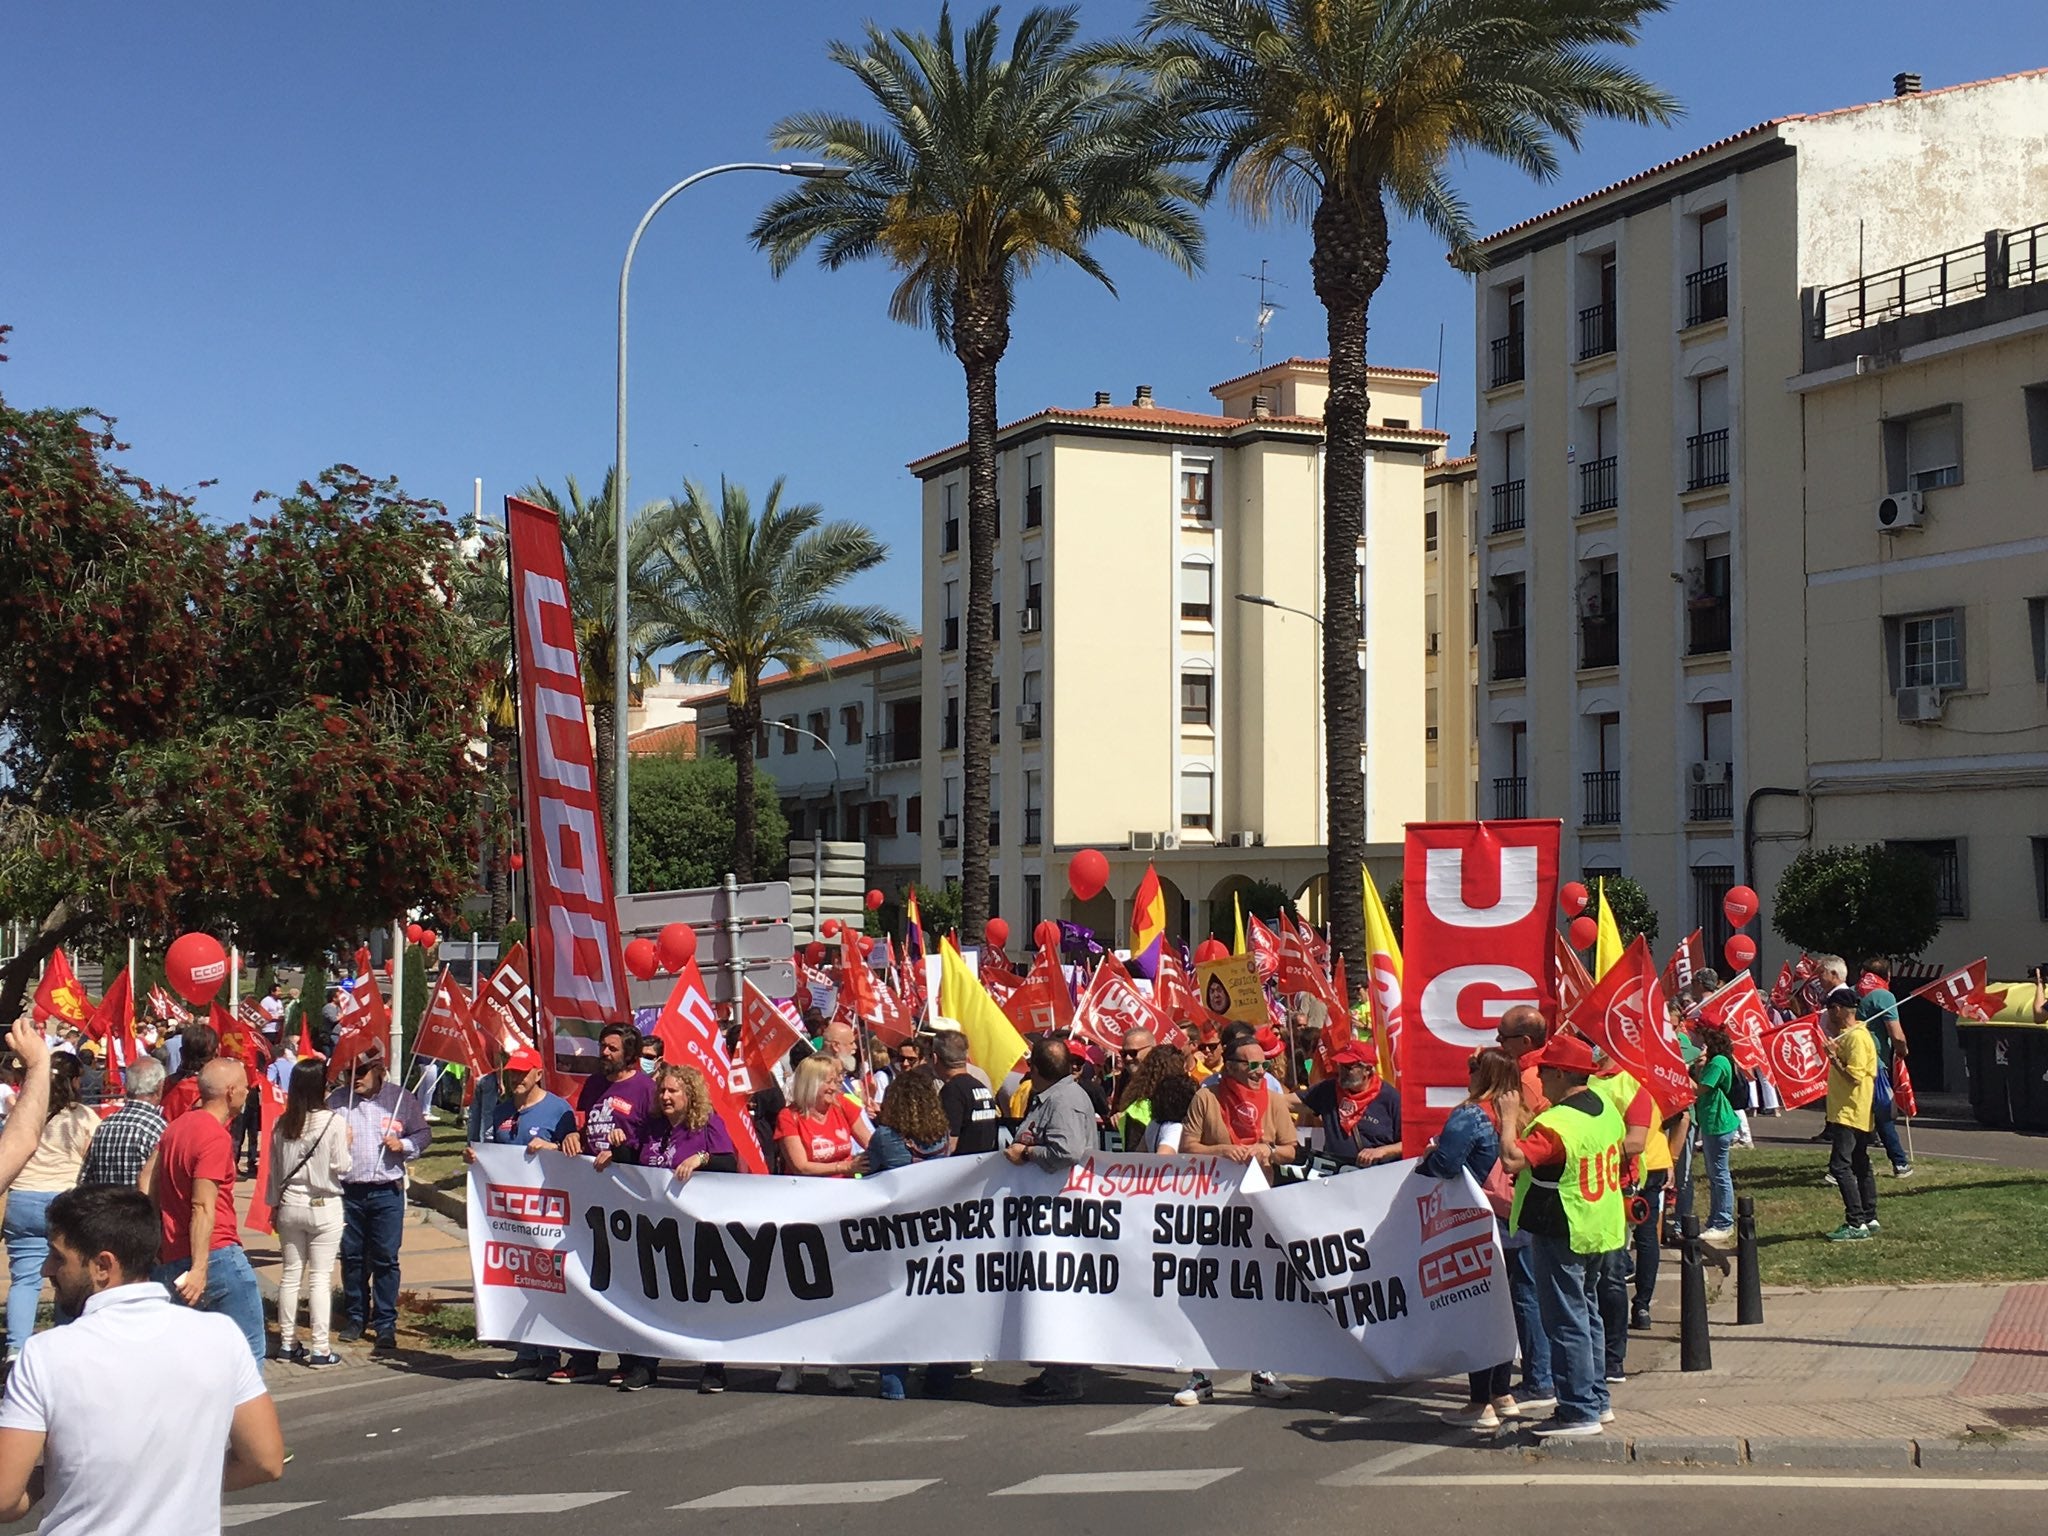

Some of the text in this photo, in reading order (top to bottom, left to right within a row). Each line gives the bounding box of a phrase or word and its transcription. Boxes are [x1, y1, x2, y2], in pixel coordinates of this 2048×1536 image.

[524, 569, 617, 1012] CCOO
[194, 963, 224, 978] CCOO
[1420, 845, 1540, 1108] UG
[1579, 1142, 1620, 1203] UG
[490, 1192, 565, 1218] CCOO
[839, 1195, 1122, 1252] CONTENER PRECIOS
[1152, 1203, 1254, 1248] SUBIR
[492, 1220, 562, 1238] extremadura
[487, 1245, 532, 1272] UGT
[905, 1246, 1120, 1296] MÁS IGUALDAD
[1152, 1252, 1220, 1298] POR
[1230, 1259, 1264, 1300] LA
[1429, 1279, 1491, 1312] extremad
